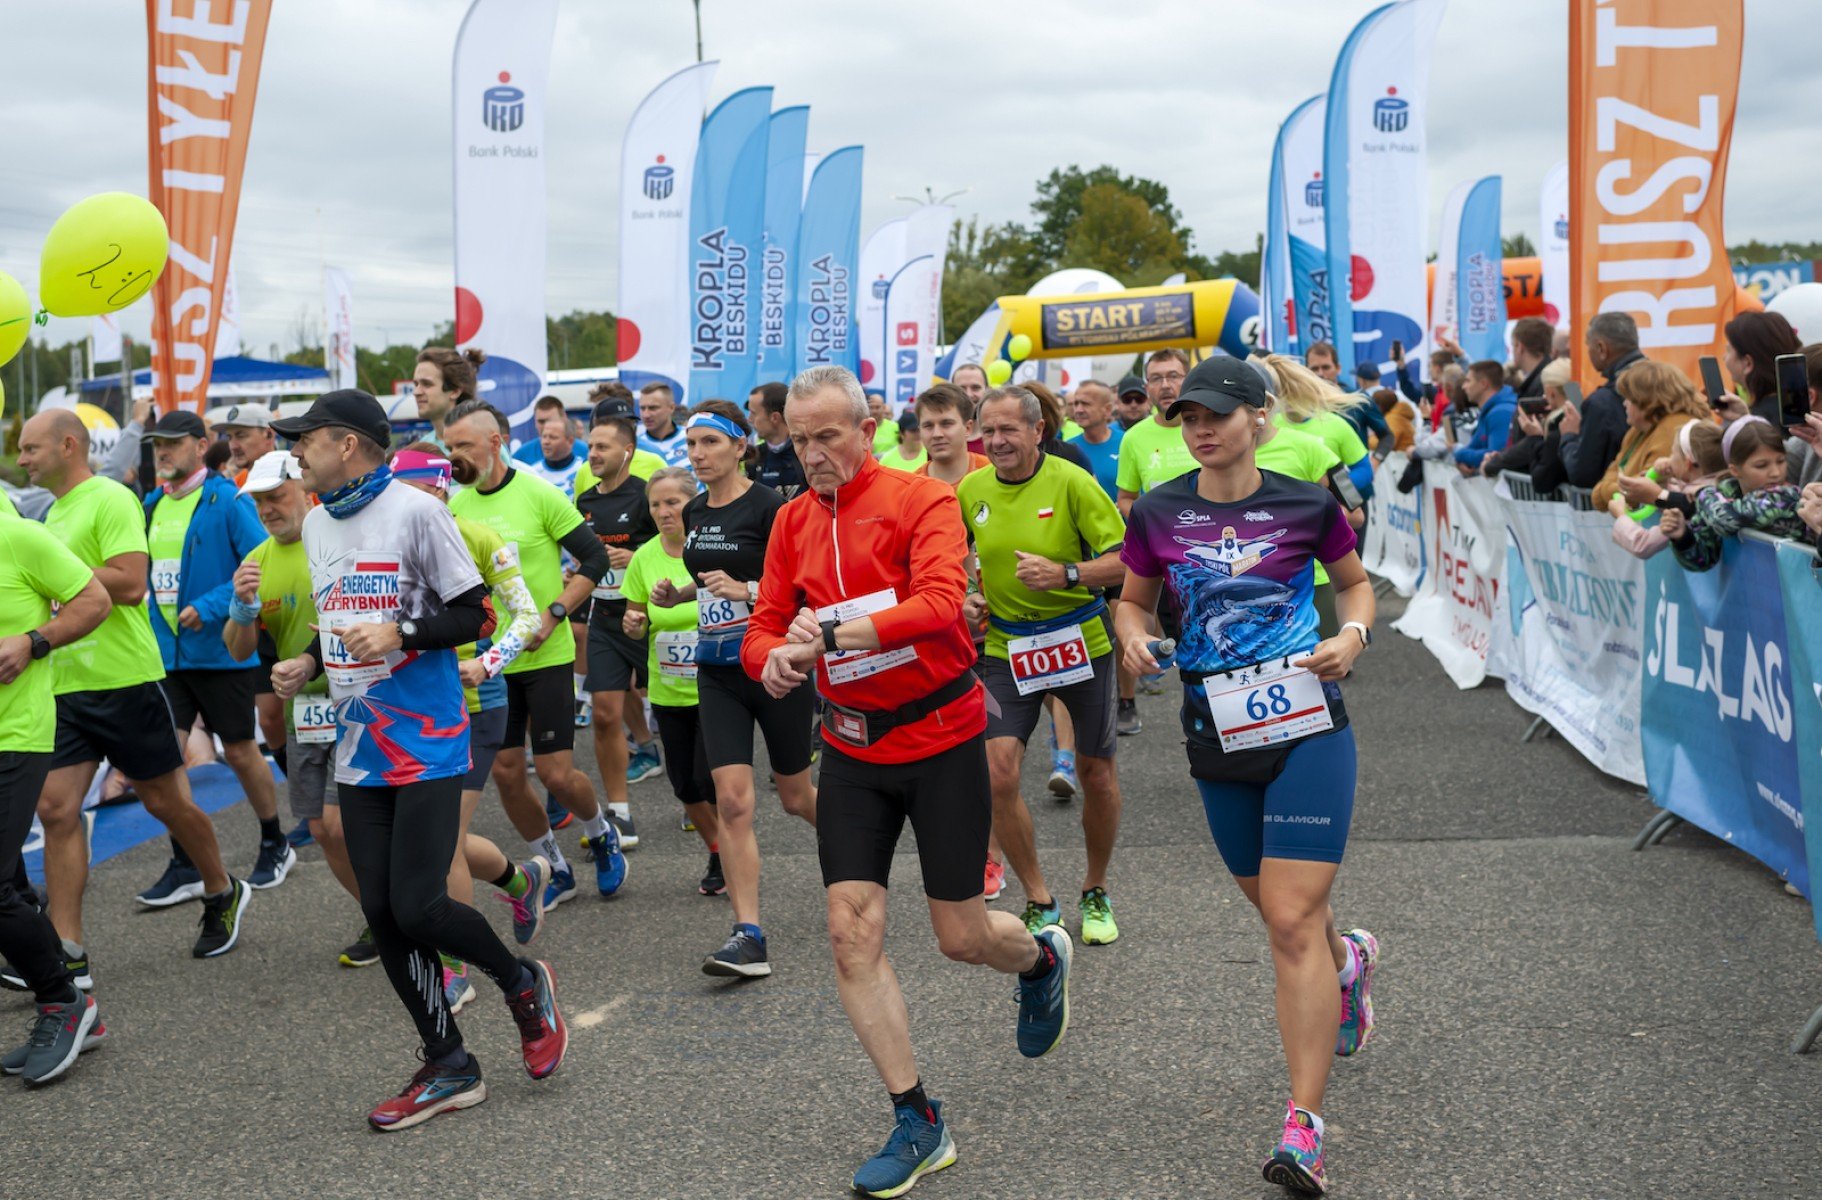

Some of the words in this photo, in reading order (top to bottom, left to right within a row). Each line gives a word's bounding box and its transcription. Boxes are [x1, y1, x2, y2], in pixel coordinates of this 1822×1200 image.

[468, 145, 499, 158] Bank
[502, 145, 539, 158] Polski
[1596, 95, 1720, 348] RUSZ
[693, 229, 725, 368] KROPLA
[726, 246, 747, 353] BESKIDU
[766, 250, 785, 346] BESKIDU
[1470, 254, 1486, 331] KROPLA
[808, 255, 831, 363] KROPLA
[833, 268, 847, 350] BESKIDU
[1056, 302, 1145, 332] START
[342, 575, 399, 596] ENERGETYK
[342, 595, 400, 611] RYBNIK
[701, 600, 734, 624] 668
[328, 637, 360, 662] 44
[668, 645, 696, 663] 52
[1017, 643, 1082, 676] 1013
[303, 705, 336, 726] 456
[1246, 683, 1291, 721] 68
[1273, 814, 1331, 826] GLAMOUR
